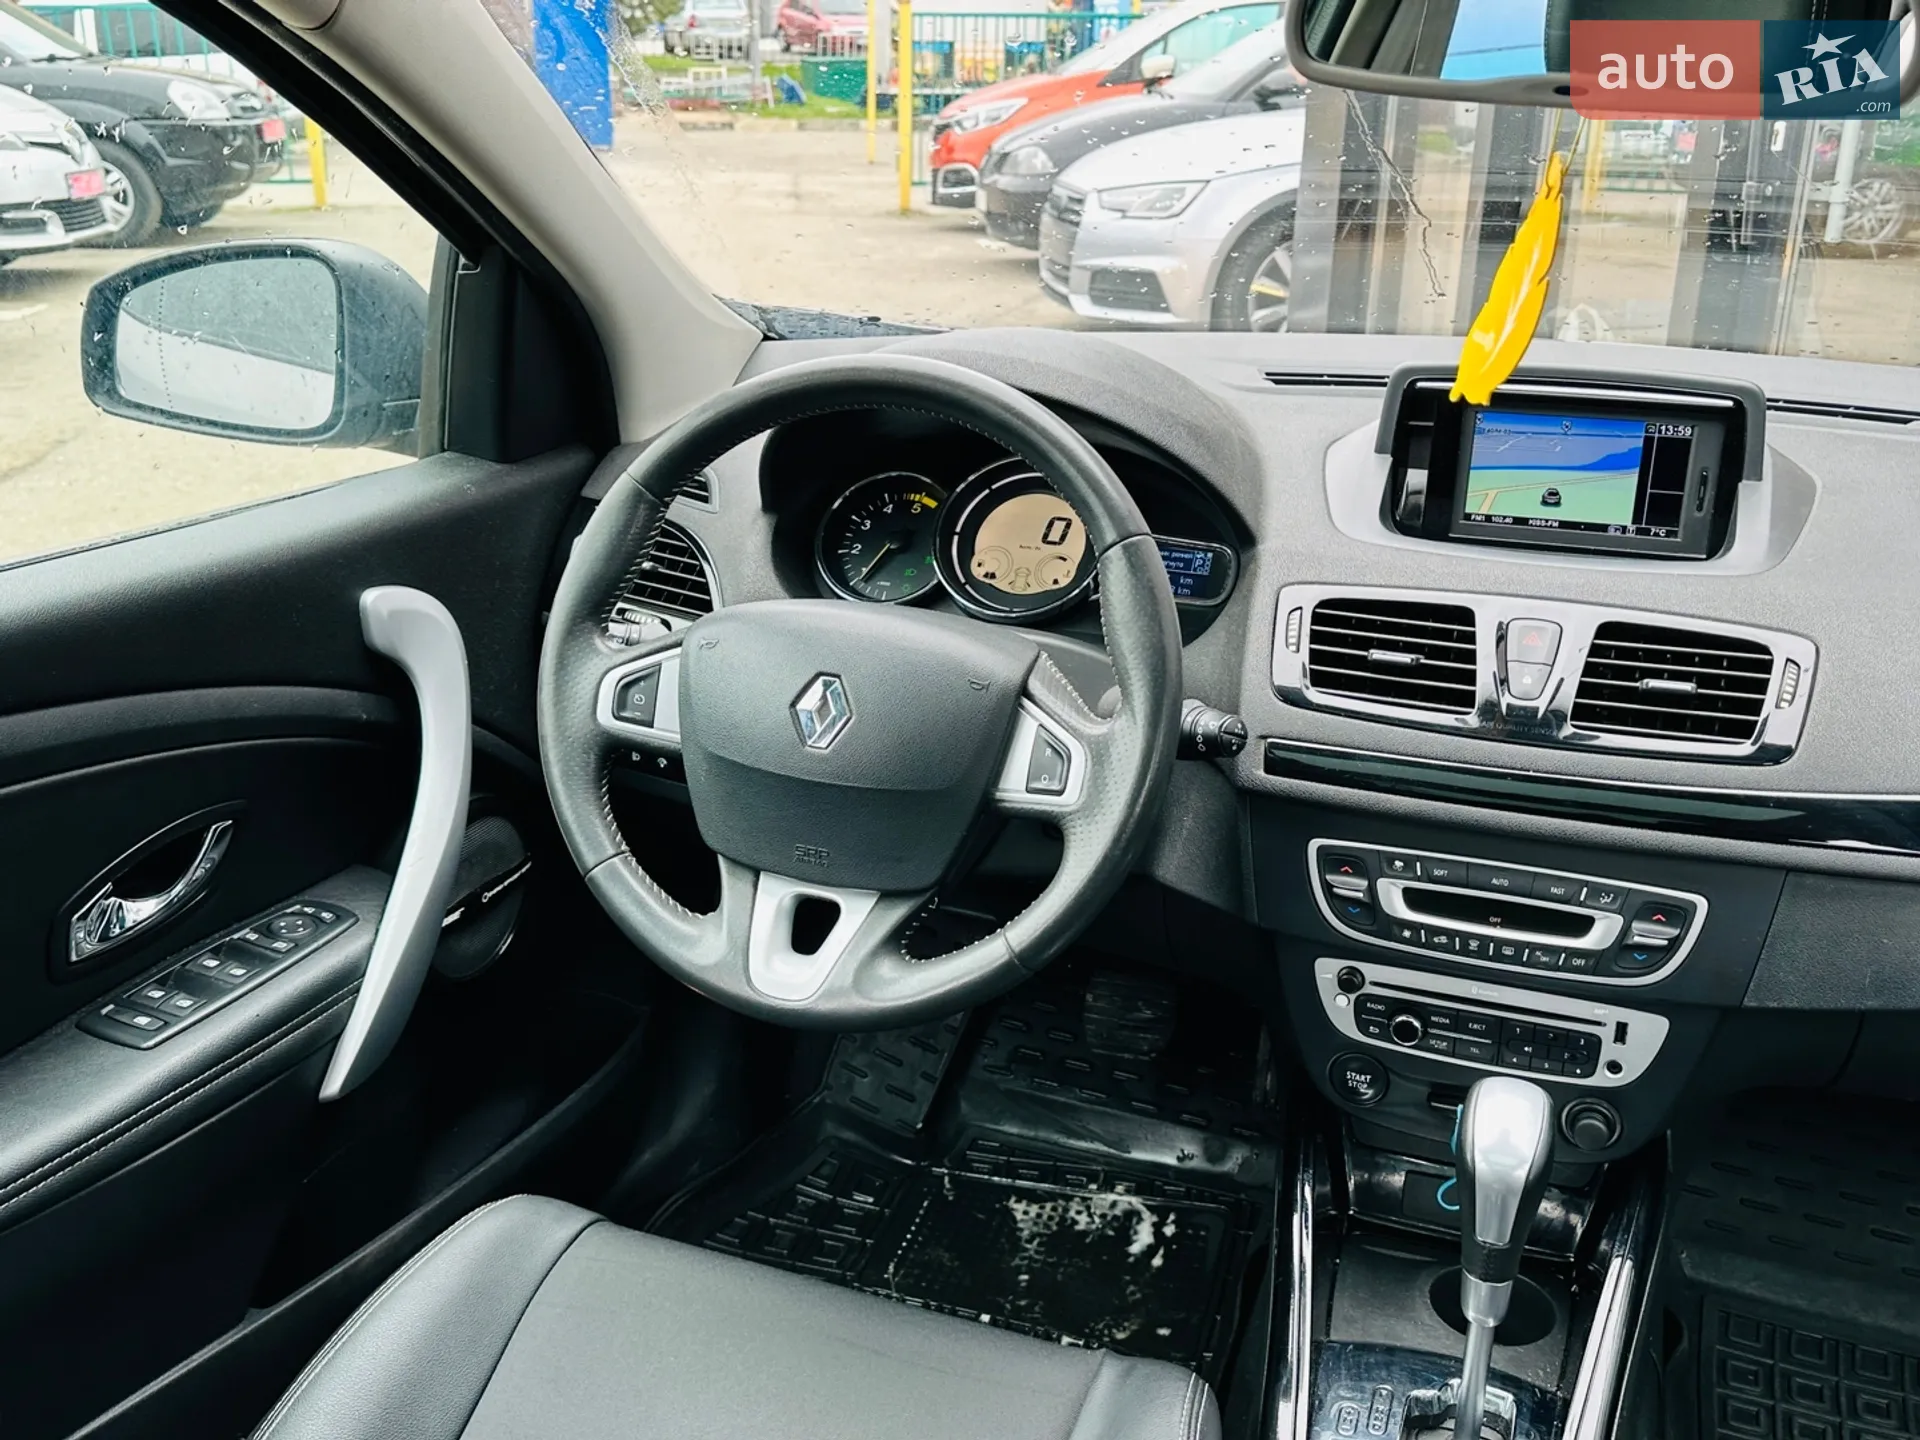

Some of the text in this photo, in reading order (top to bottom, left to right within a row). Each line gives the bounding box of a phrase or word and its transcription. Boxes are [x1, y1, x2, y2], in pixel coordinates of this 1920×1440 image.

[1660, 425, 1692, 436] 13:59
[883, 503, 893, 514] 4
[911, 503, 922, 514] 5
[861, 520, 871, 531] 3
[1041, 516, 1073, 546] 0
[851, 543, 862, 555] 2
[1180, 576, 1193, 585] km
[1177, 586, 1191, 595] km
[1433, 868, 1448, 877] SOFT
[1491, 877, 1509, 887] AUTO
[1550, 886, 1566, 896] FAST
[1572, 957, 1586, 967] OFF
[1367, 1002, 1386, 1011] RADIO
[1430, 1015, 1450, 1024] MEDIA
[1468, 1022, 1486, 1031] EJECT
[1346, 1071, 1372, 1083] START
[1348, 1080, 1368, 1089] STOP
